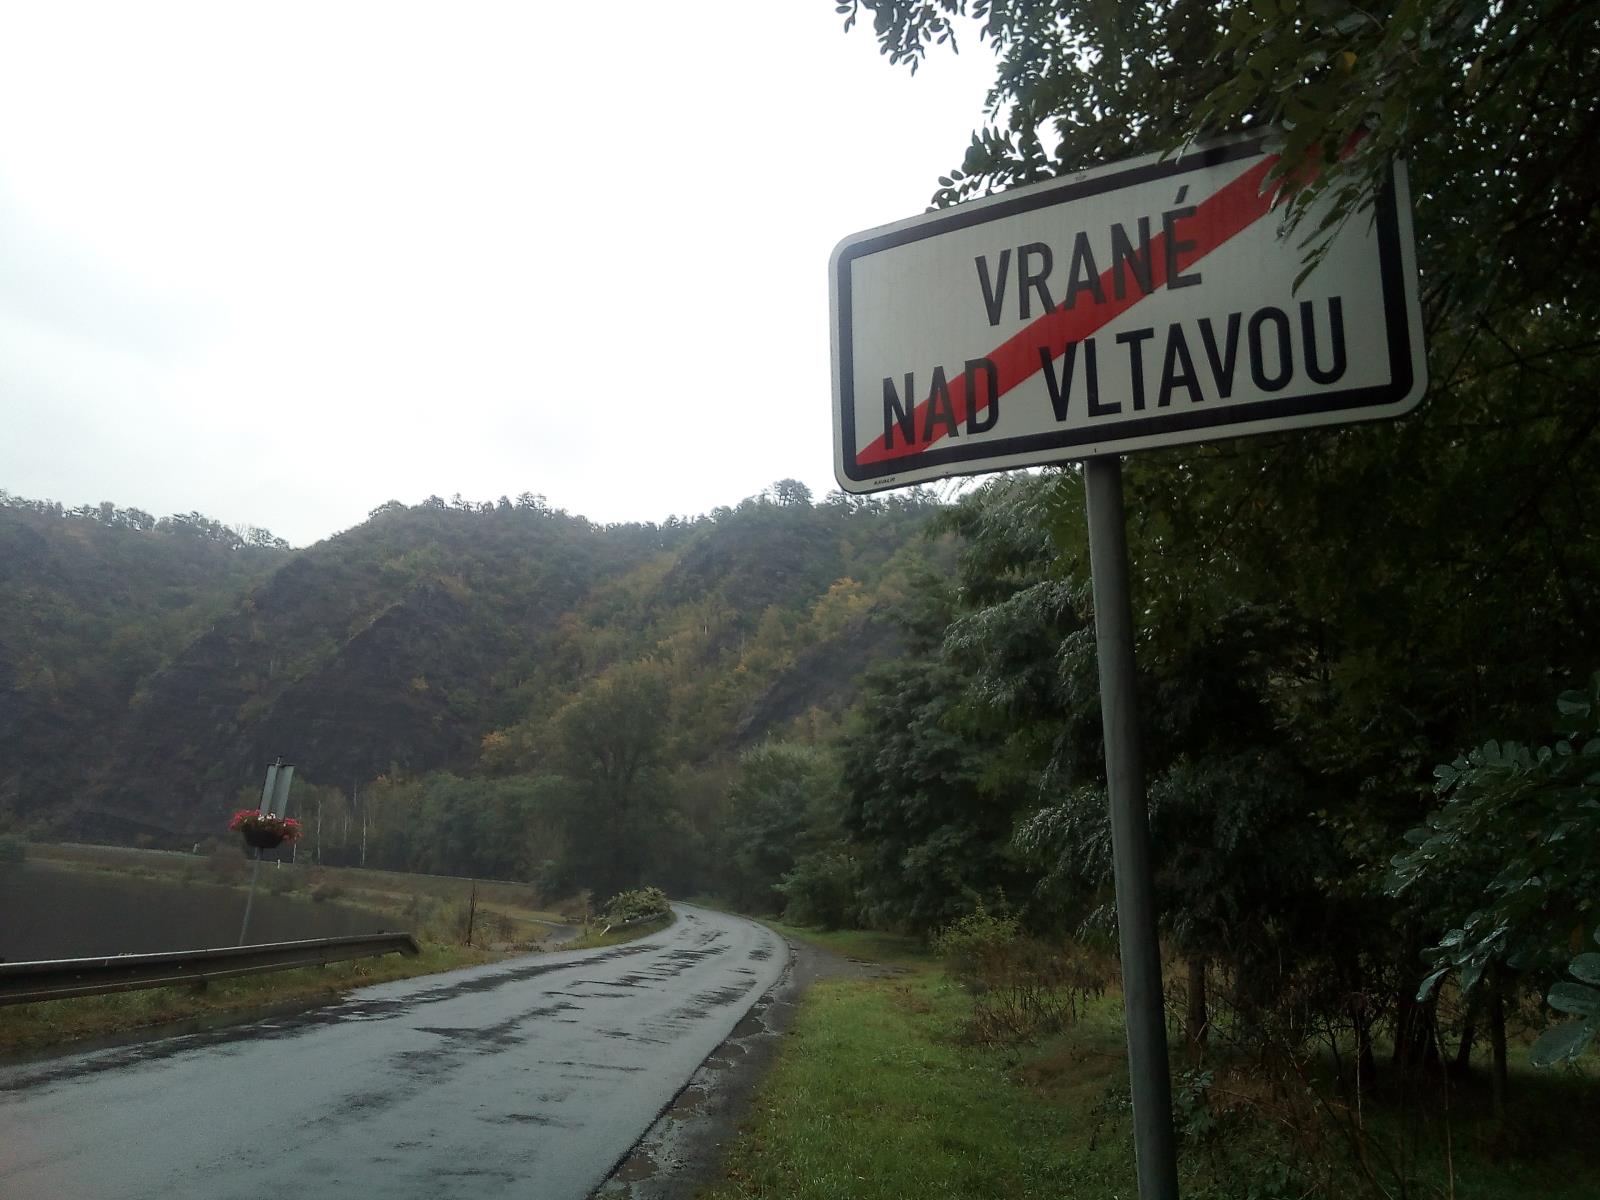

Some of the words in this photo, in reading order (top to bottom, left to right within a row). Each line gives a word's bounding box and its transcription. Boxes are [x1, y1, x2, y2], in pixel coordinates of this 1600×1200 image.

[974, 185, 1202, 326] VRANÉ
[883, 357, 999, 450] NAD
[1040, 296, 1347, 421] VLTAVOU
